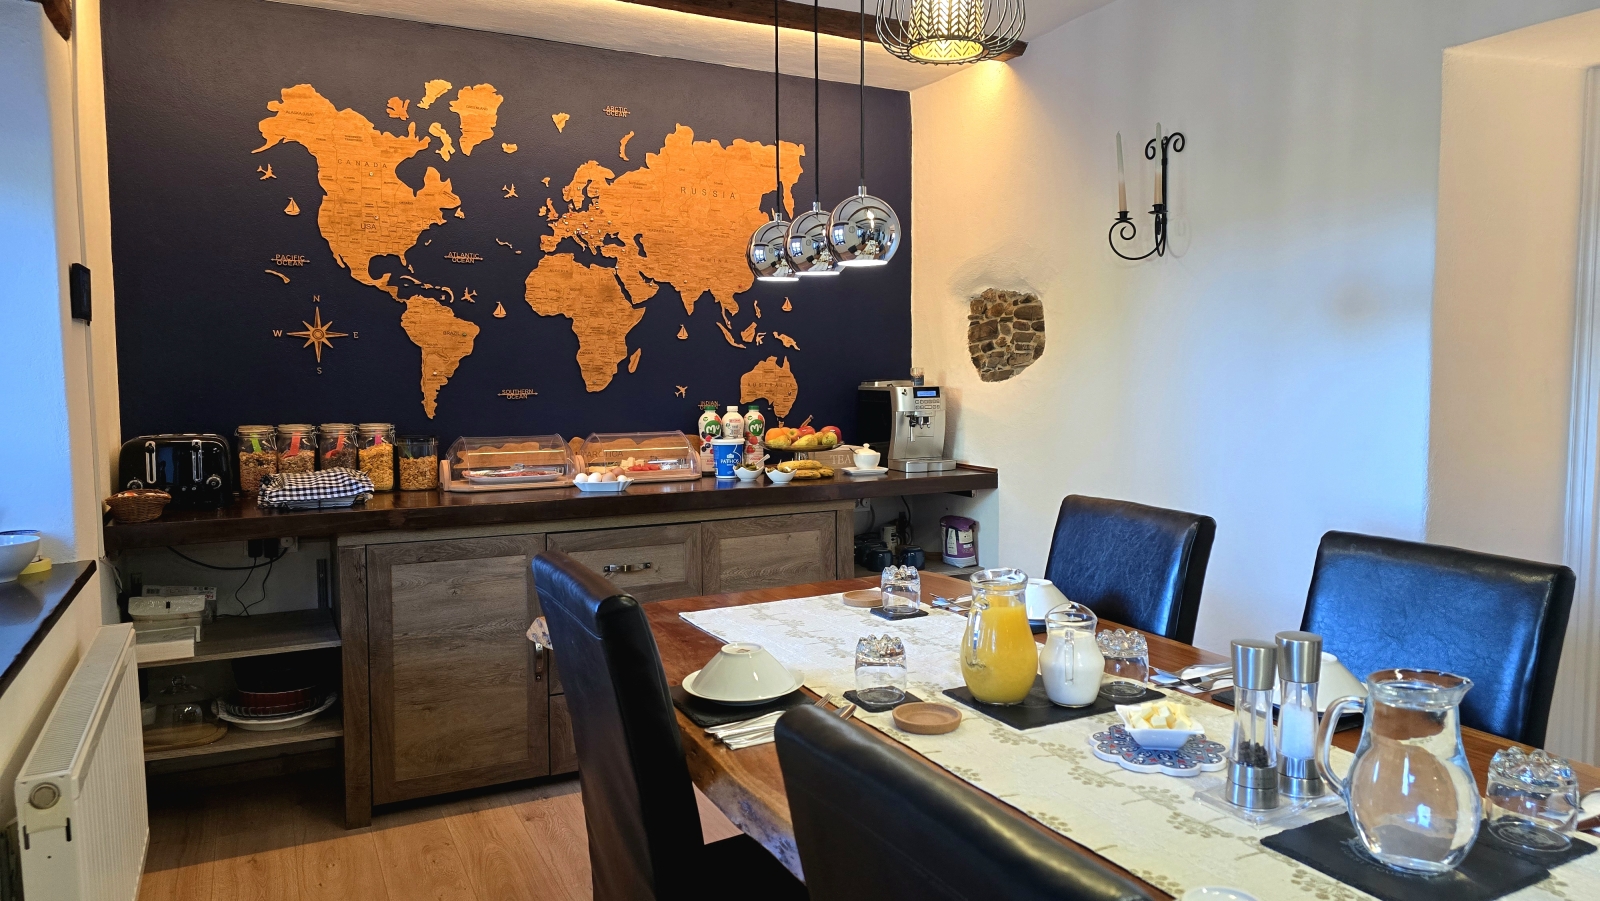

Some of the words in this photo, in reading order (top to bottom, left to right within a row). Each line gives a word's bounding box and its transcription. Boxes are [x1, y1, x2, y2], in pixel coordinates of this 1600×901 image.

[337, 158, 388, 169] CANADA
[680, 186, 736, 200] RUSSIA
[275, 253, 305, 261] PACIFIC
[448, 251, 480, 259] ATLANTIC
[313, 294, 320, 302] N
[272, 329, 283, 337] W
[353, 331, 359, 339] E
[316, 367, 322, 375] S
[830, 454, 852, 465] TEA
